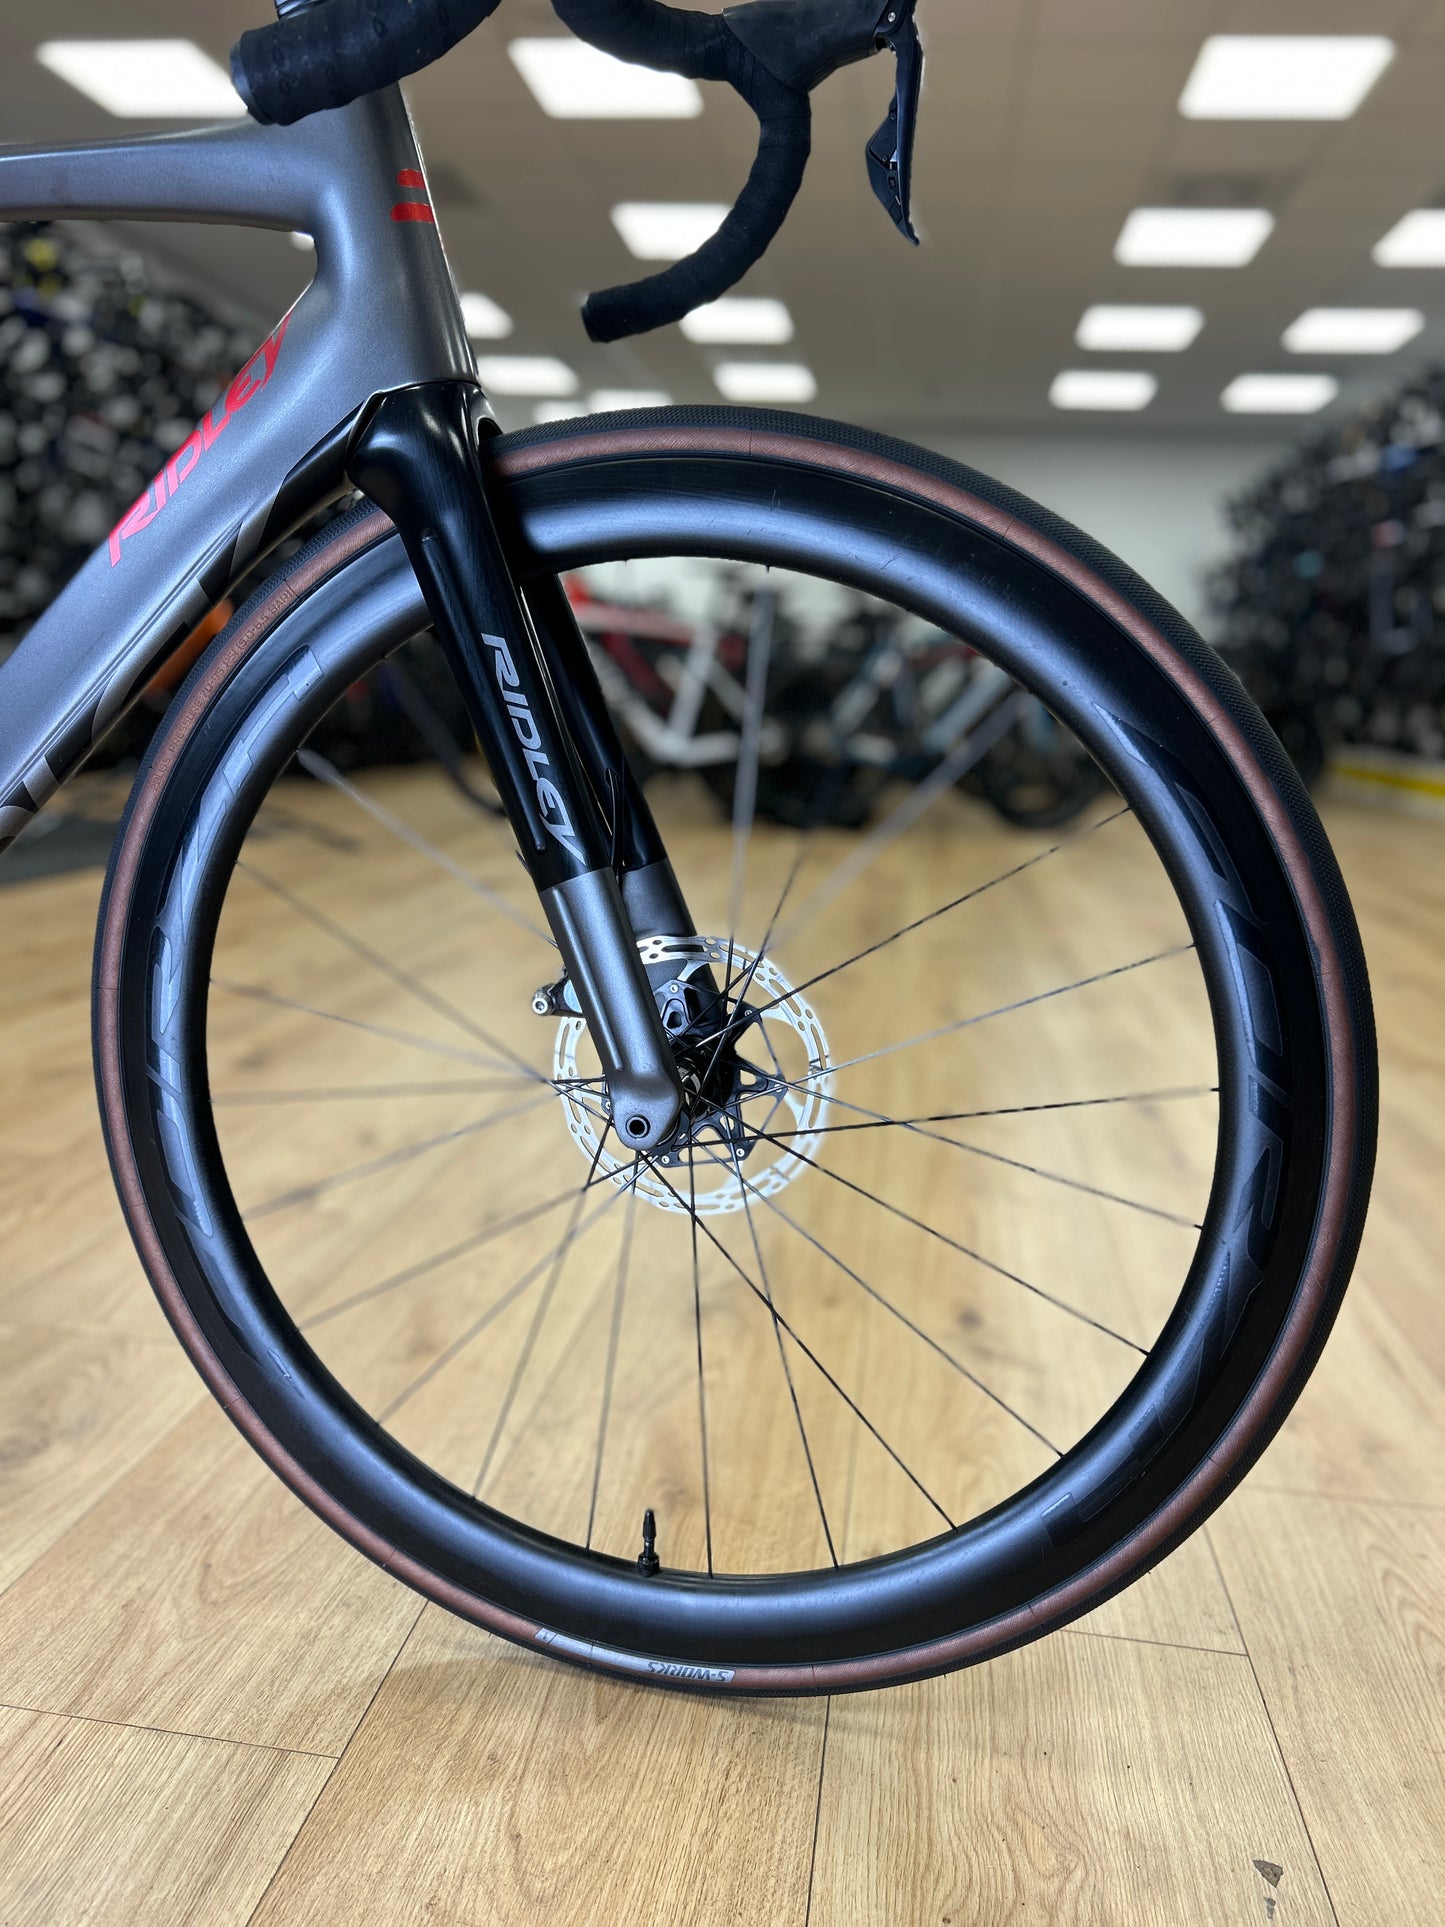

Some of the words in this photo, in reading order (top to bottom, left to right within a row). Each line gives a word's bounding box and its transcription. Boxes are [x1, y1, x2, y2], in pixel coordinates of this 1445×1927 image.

[109, 311, 293, 568] RIDLEY
[168, 699, 204, 754] PRESSURE
[222, 647, 239, 669] PSI
[481, 632, 587, 867] RIDLEY
[647, 1660, 729, 1683] S-WORKS
